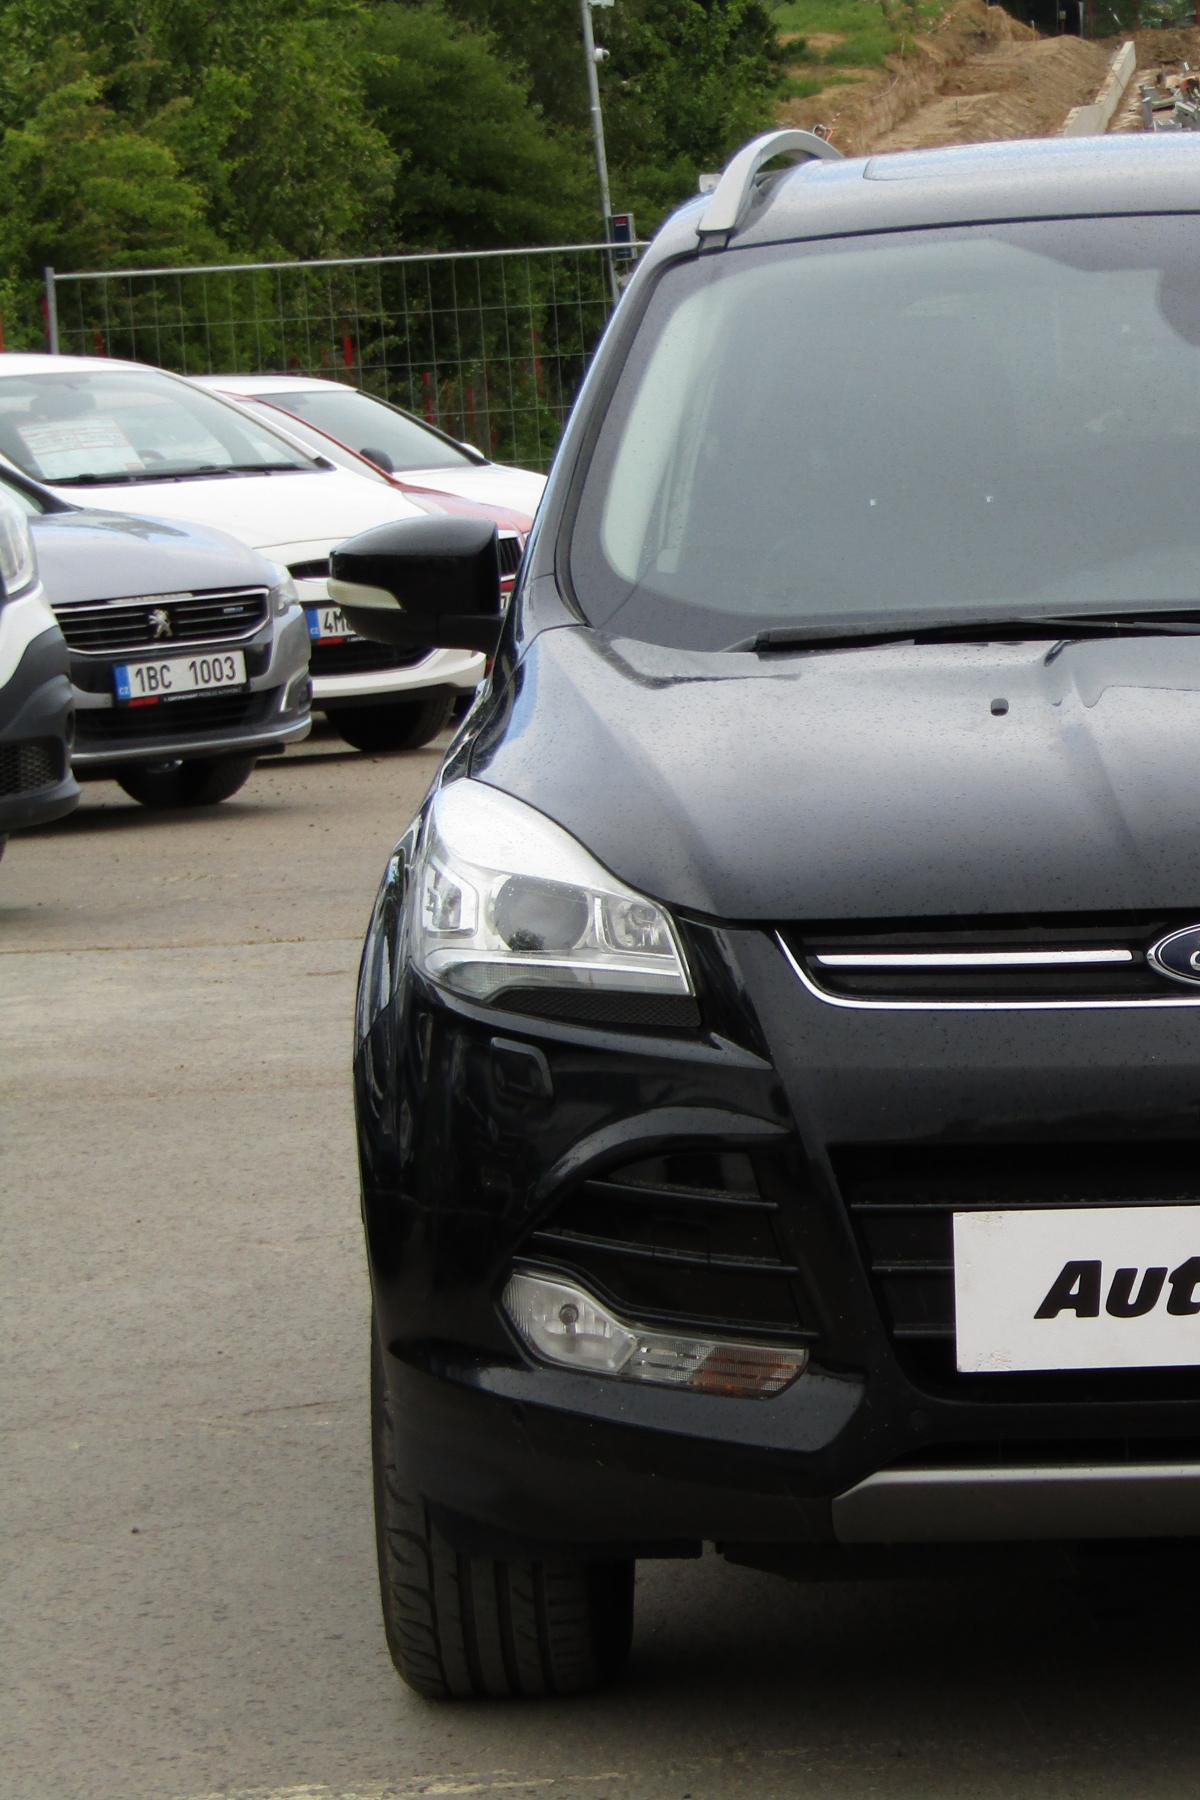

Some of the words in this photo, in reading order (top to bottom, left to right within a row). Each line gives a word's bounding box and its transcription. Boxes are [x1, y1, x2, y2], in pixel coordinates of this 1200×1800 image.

[135, 664, 172, 692] 1BC
[189, 656, 236, 686] 1003
[119, 687, 129, 695] CZ
